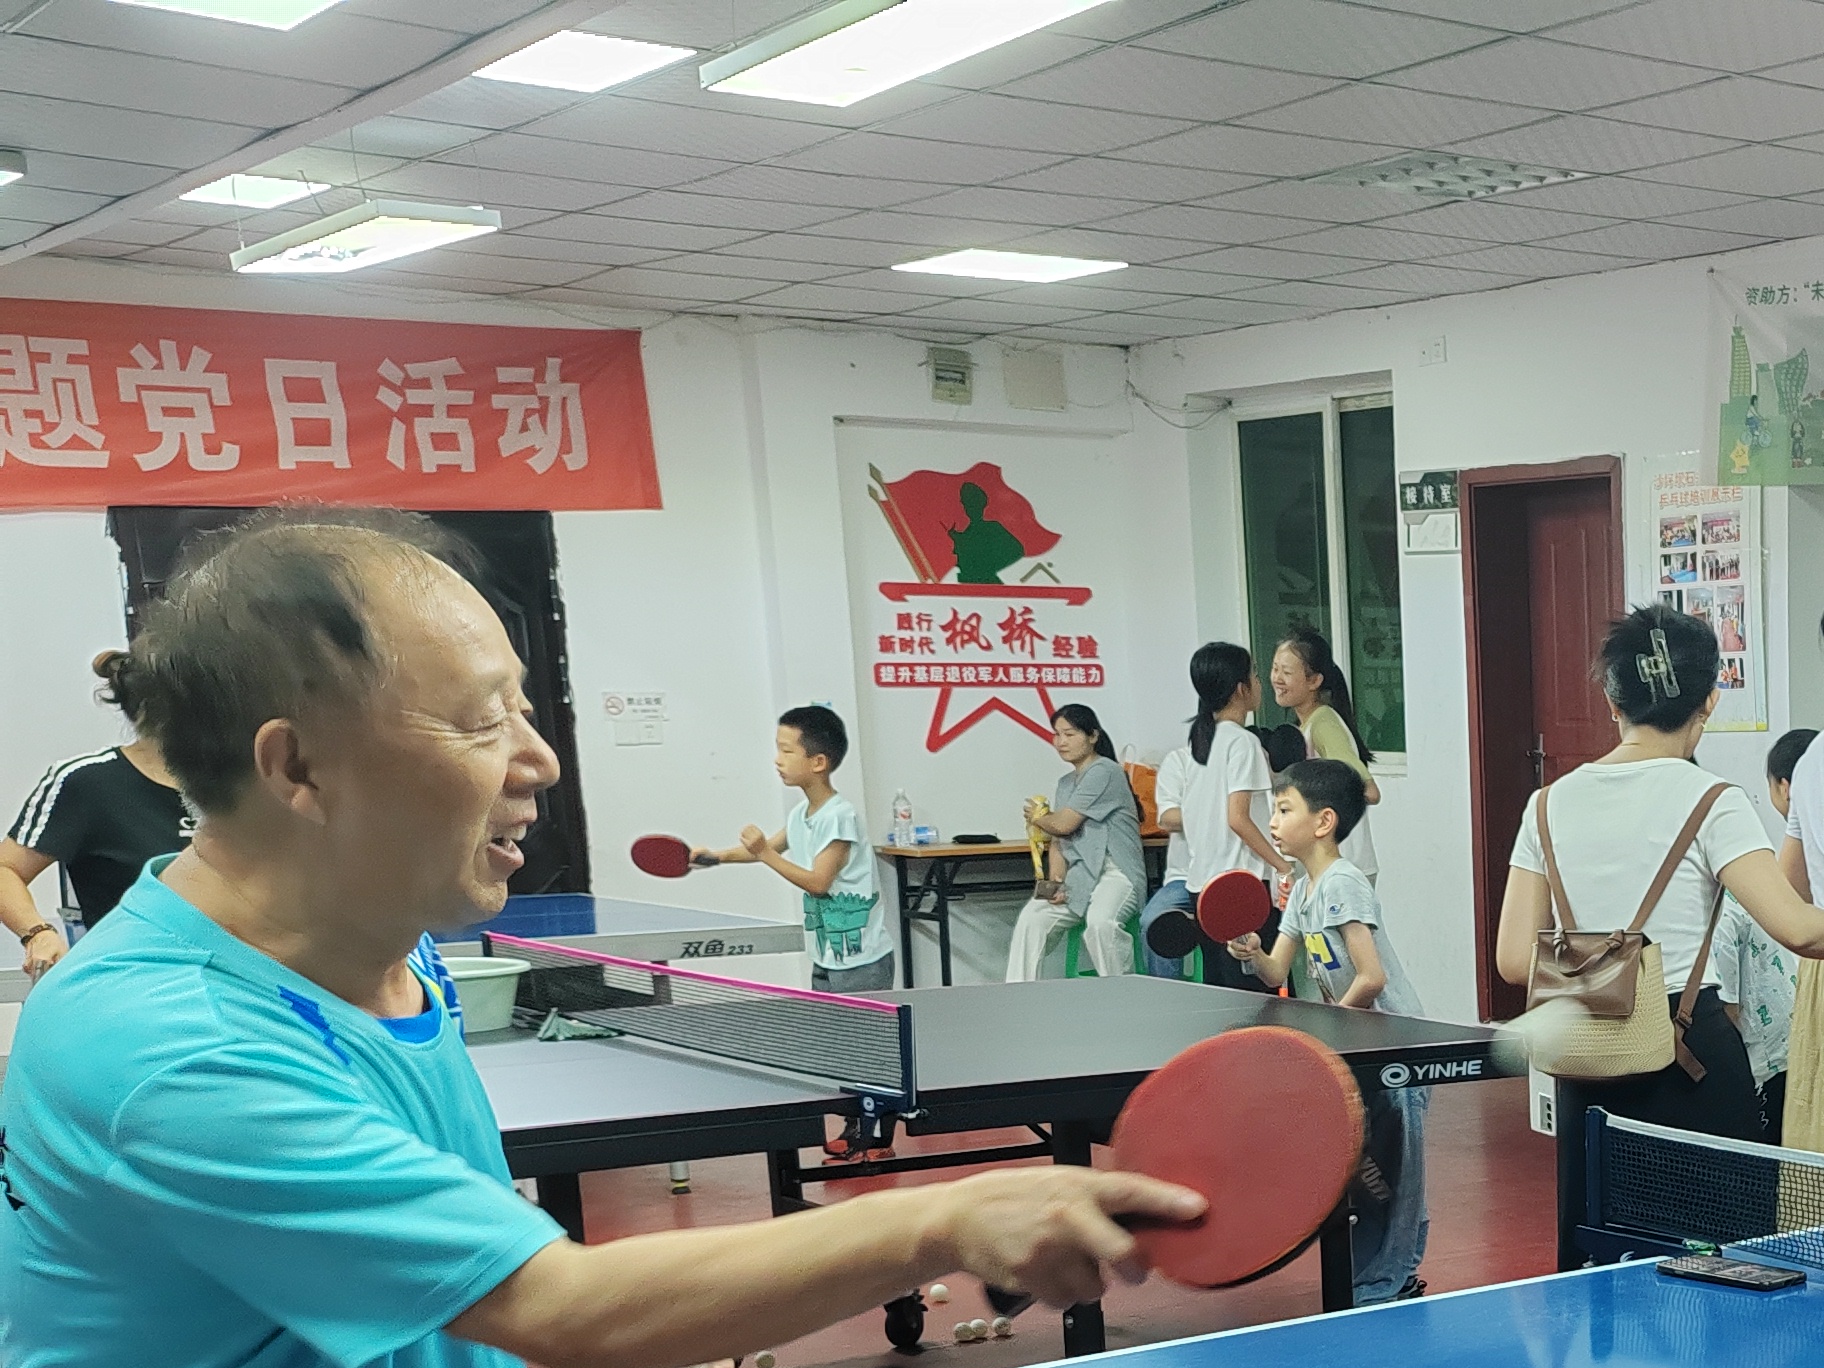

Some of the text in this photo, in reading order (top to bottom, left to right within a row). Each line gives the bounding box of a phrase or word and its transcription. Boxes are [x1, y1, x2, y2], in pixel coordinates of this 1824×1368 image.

[0, 333, 589, 474] 题党日活动
[1405, 483, 1453, 505] 接待室
[939, 606, 1047, 660] 枫桥
[878, 634, 936, 655] 新时代
[1051, 635, 1100, 659] 经验
[879, 664, 1101, 685] 提升基层退役军人服务保障能力
[679, 939, 754, 959] 双鱼 233
[1413, 1059, 1483, 1080] YINHE
